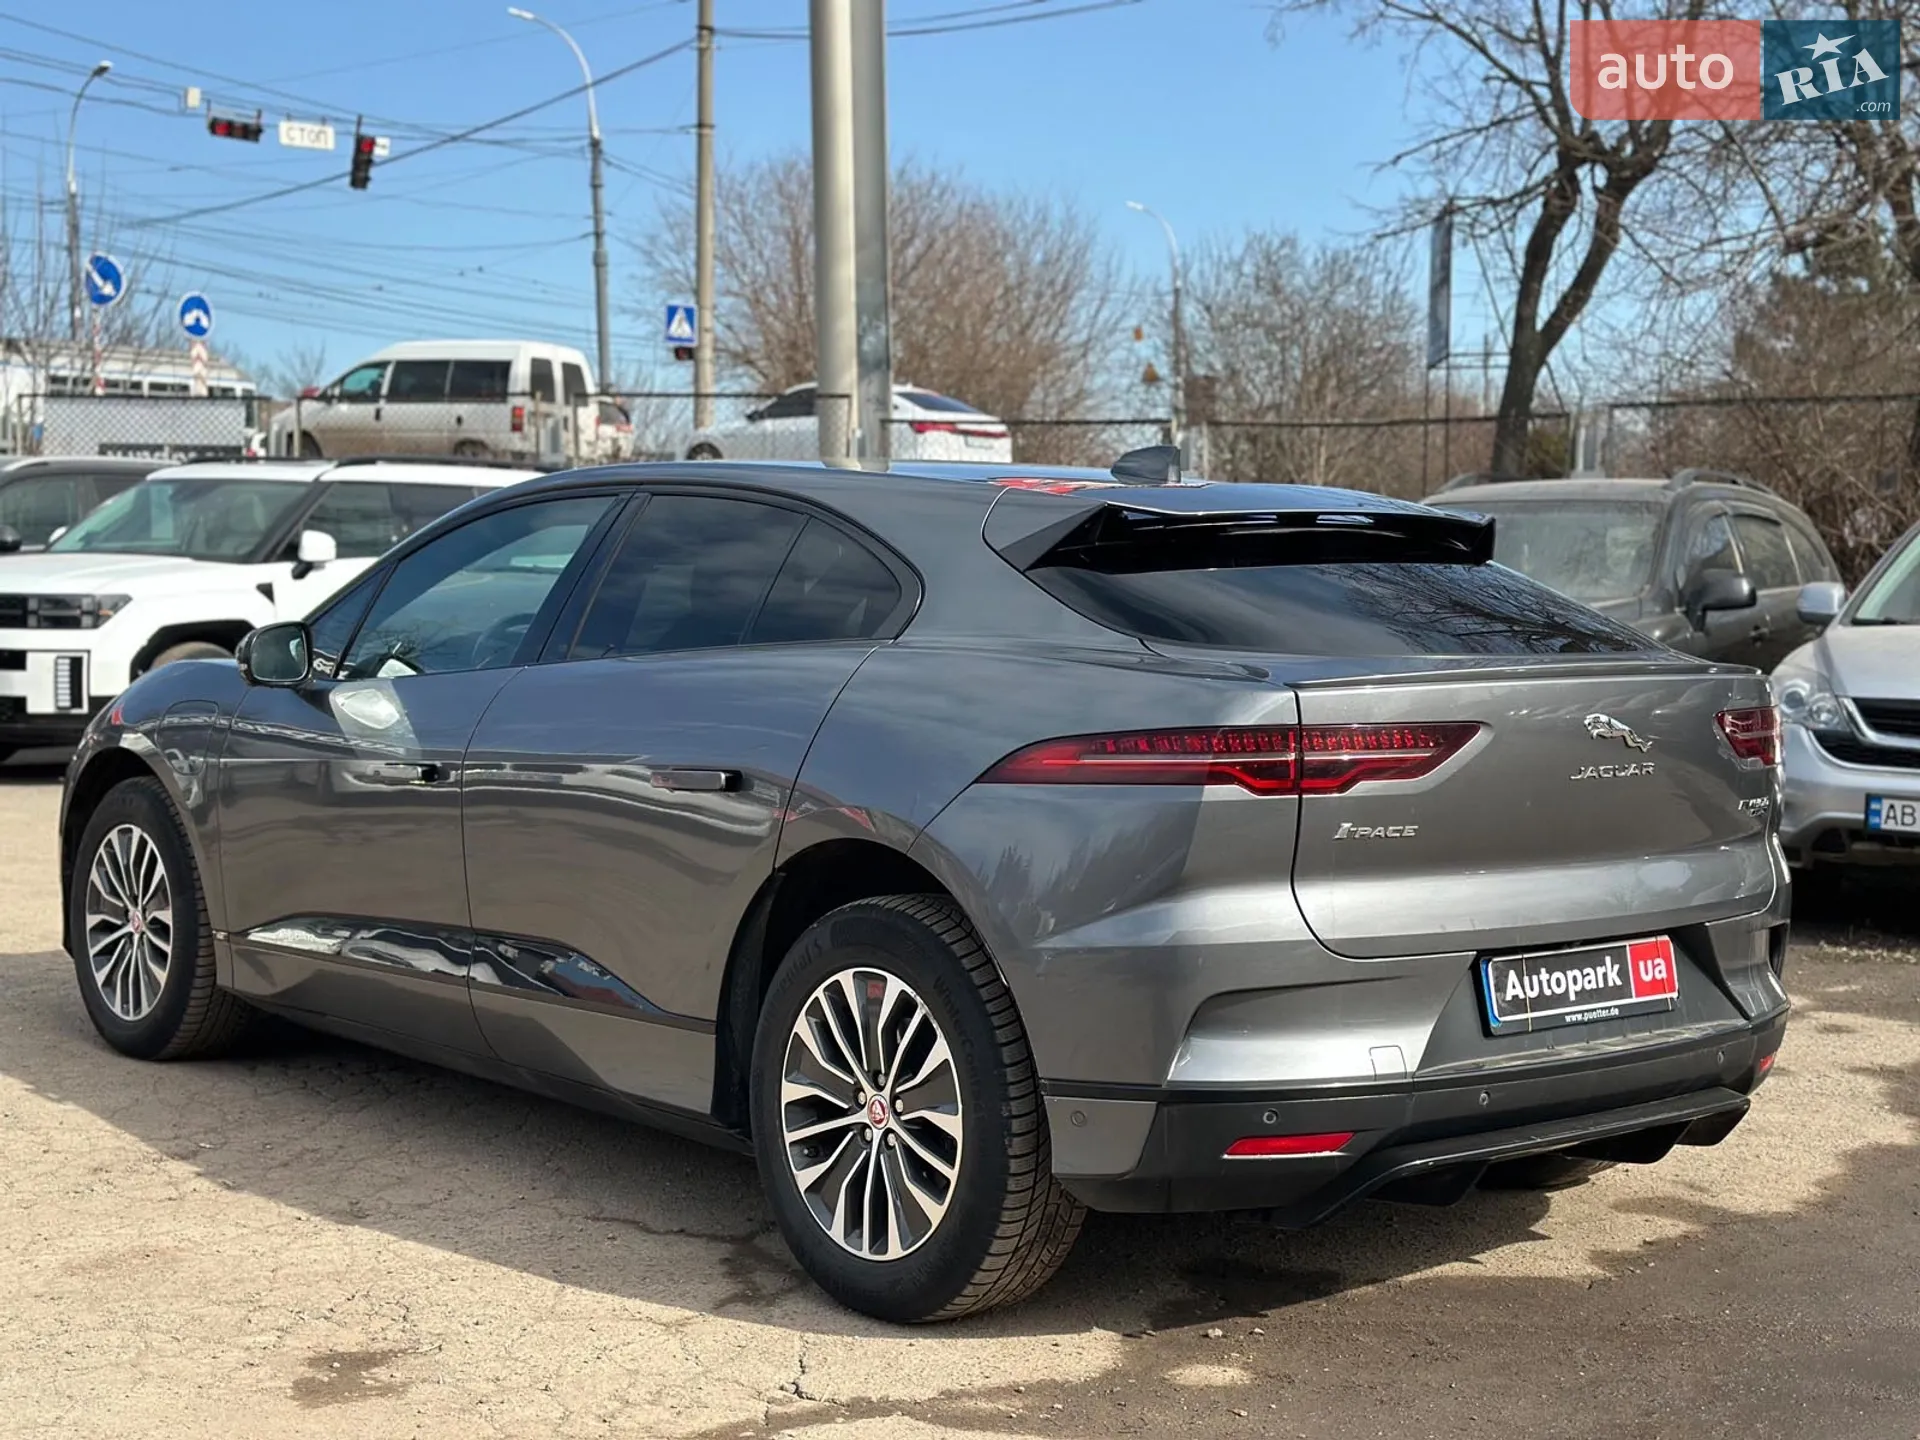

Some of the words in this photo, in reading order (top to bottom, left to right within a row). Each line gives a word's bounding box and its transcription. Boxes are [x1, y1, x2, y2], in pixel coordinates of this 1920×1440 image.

[1570, 762, 1655, 779] JAGUAR
[1334, 822, 1419, 839] I-PACE
[1505, 956, 1623, 1001] Autopark
[1639, 957, 1667, 982] ua
